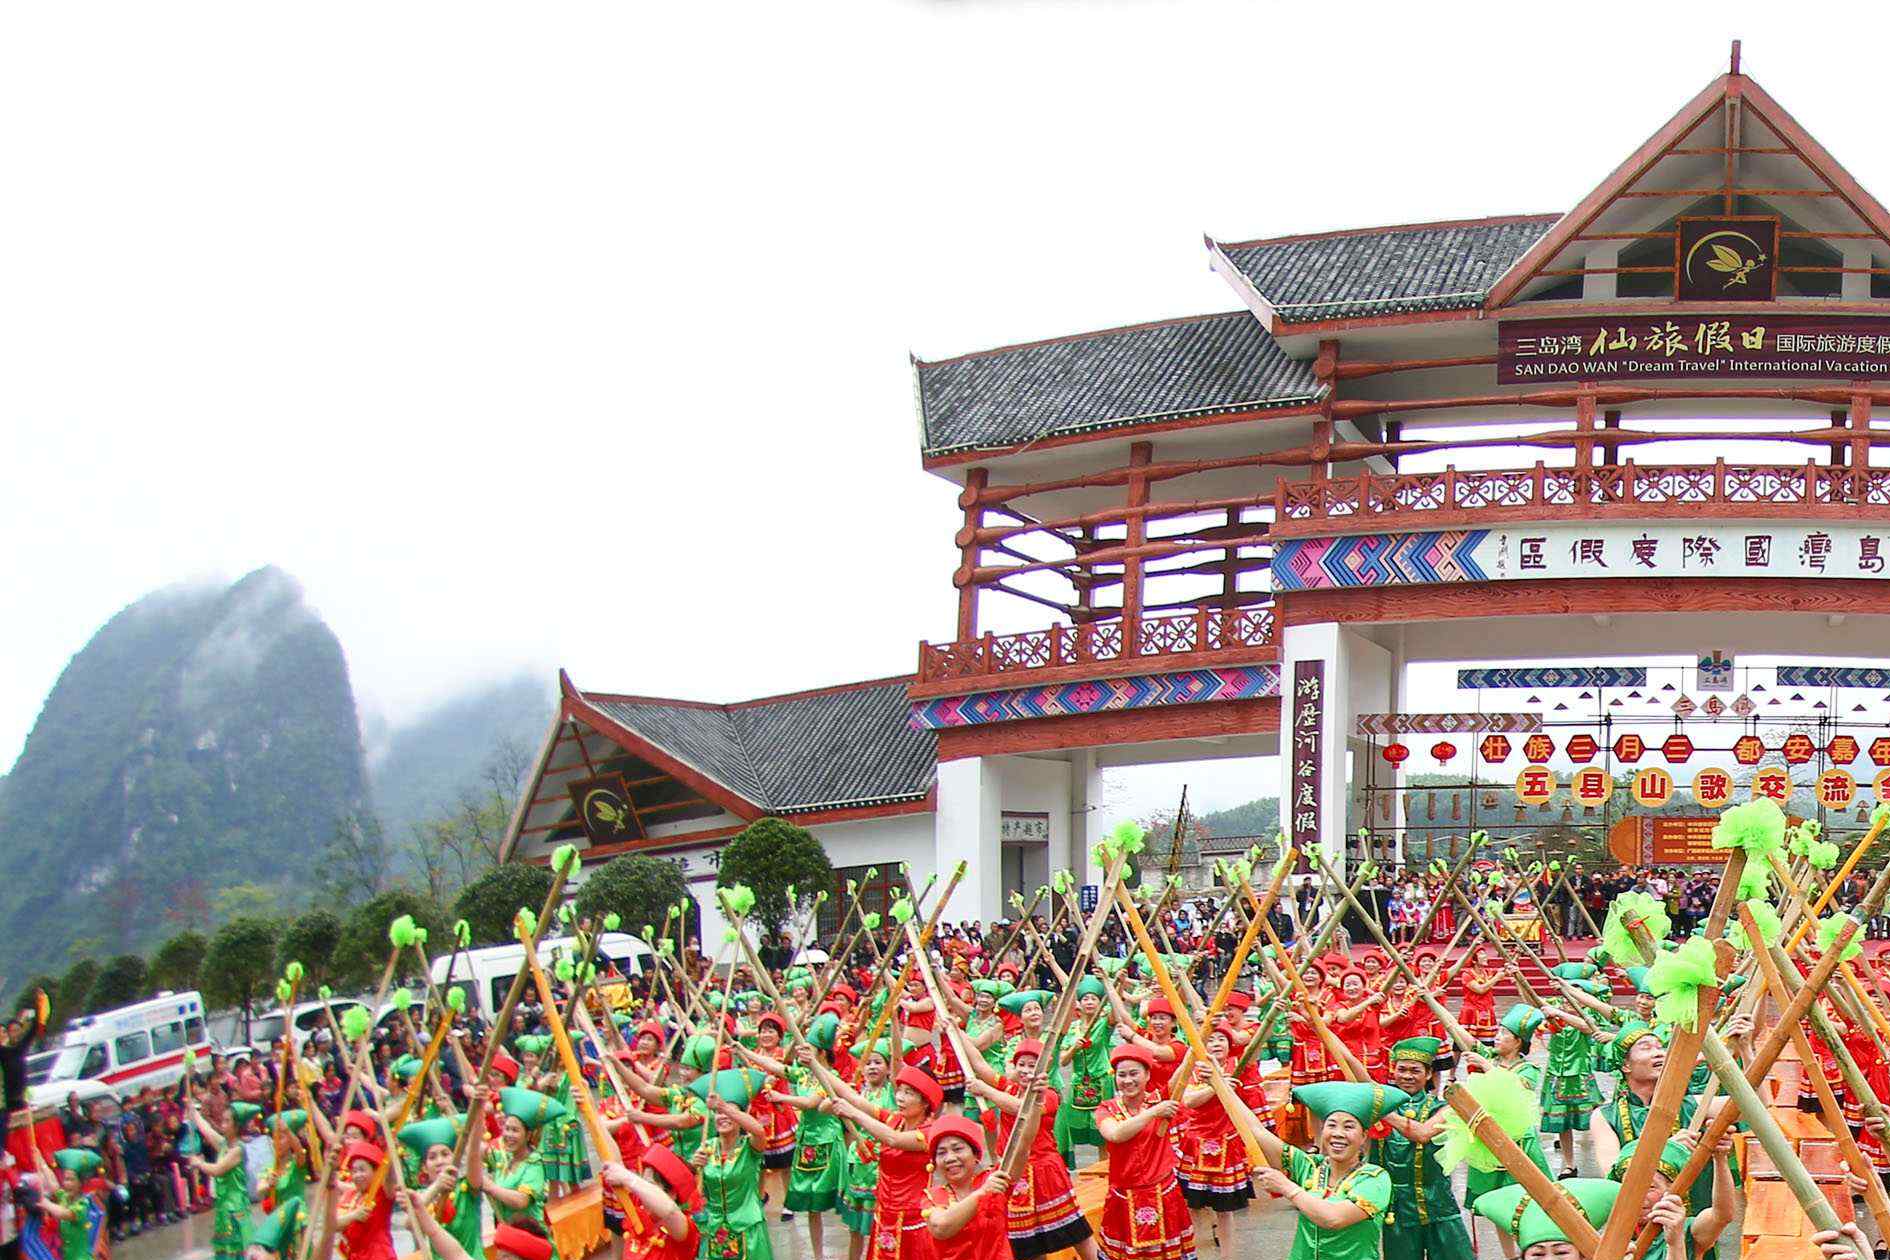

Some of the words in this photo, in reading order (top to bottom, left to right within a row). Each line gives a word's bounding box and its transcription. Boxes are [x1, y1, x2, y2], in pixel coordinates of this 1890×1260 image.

[1515, 335, 1583, 356] 三岛湾
[1589, 320, 1766, 357] 仙旅假日
[1515, 364, 1544, 376] SAN
[1548, 362, 1580, 374] DAO
[1583, 361, 1618, 373] WAN
[1729, 359, 1822, 371] International
[1825, 360, 1888, 372] Vacation
[1484, 735, 1691, 761] 壮族三月三
[1294, 676, 1321, 857] 游歷河谷度假
